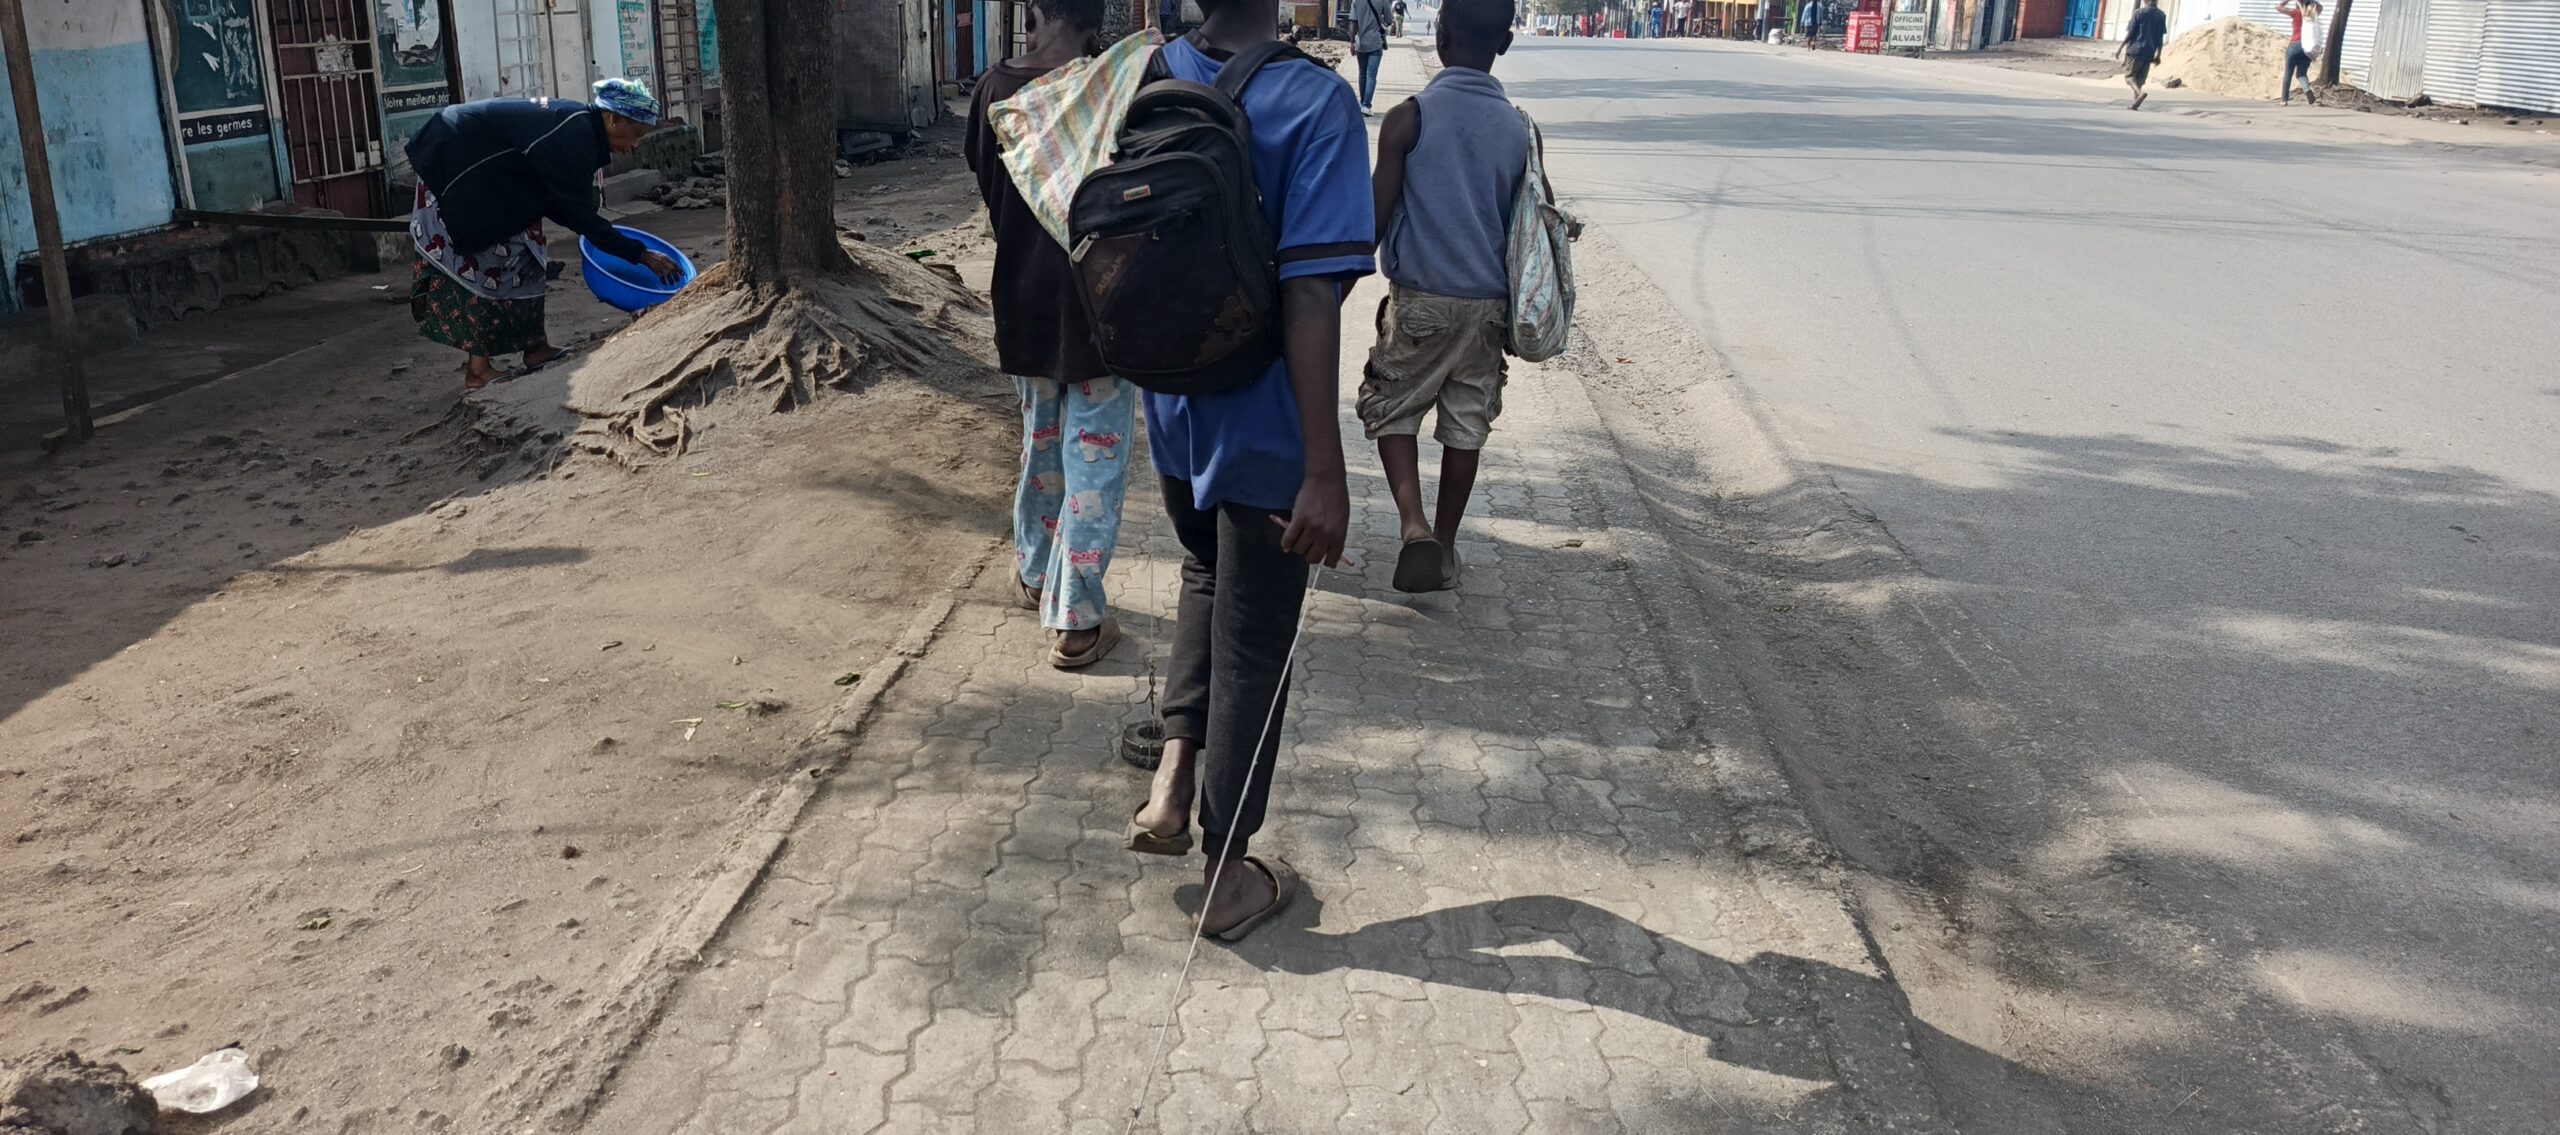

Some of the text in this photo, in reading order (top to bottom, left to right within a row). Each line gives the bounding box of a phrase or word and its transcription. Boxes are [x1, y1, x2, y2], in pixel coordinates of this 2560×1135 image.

[1892, 34, 1922, 42] ALVAS
[384, 97, 403, 109] Votre
[406, 93, 436, 106] meilleure
[197, 121, 212, 135] les
[217, 118, 252, 138] germes
